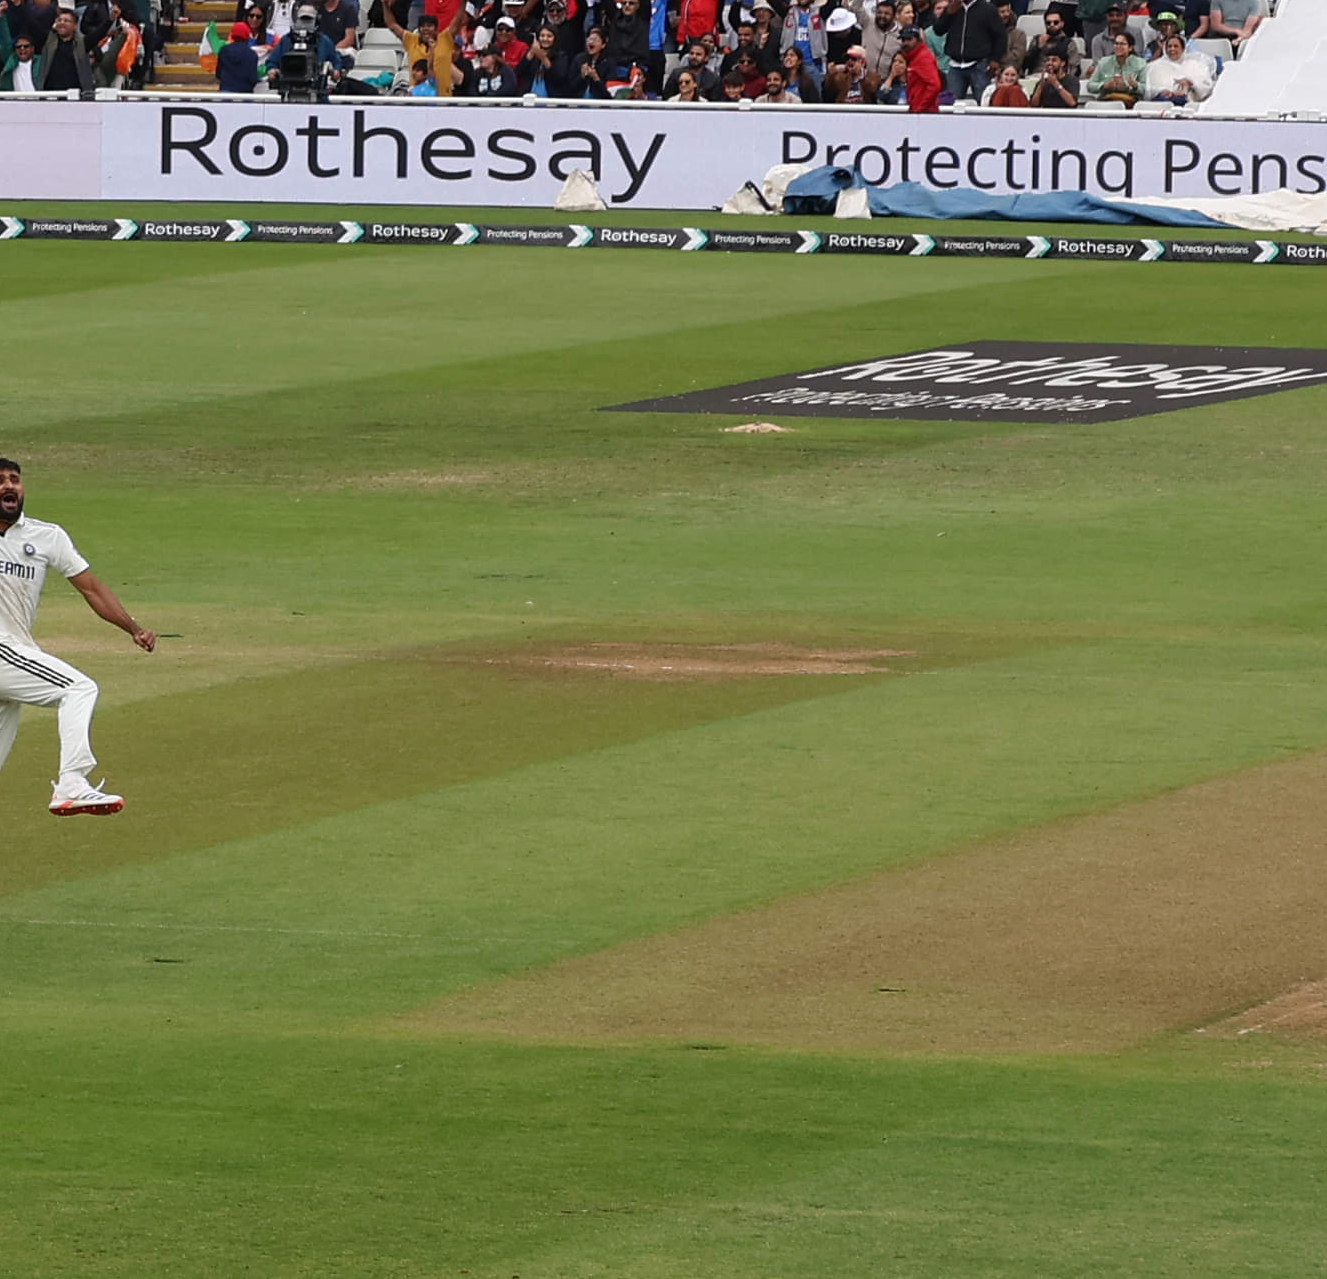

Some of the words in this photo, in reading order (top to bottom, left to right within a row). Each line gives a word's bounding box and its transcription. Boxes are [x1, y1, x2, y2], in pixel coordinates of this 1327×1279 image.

[160, 107, 667, 202] Rothesay
[32, 223, 72, 233] Protecting
[73, 223, 107, 233] Pensions
[145, 223, 220, 238] Rothesay
[258, 225, 297, 236] Protecting
[298, 225, 333, 236] Pensions
[373, 224, 448, 241] Rothesay
[487, 229, 527, 240] Protecting
[528, 229, 563, 240] Pensions
[601, 229, 677, 246] Rothesay
[715, 234, 755, 245] Protecting
[756, 234, 791, 245] Pensions
[829, 234, 904, 250] Rothesay
[944, 241, 984, 252] Protecting
[985, 241, 1020, 252] Pensions
[1059, 240, 1133, 257] Rothesay
[1172, 244, 1213, 255] Protecting
[1214, 244, 1249, 255] Pensions
[797, 351, 1327, 399] Rothesay
